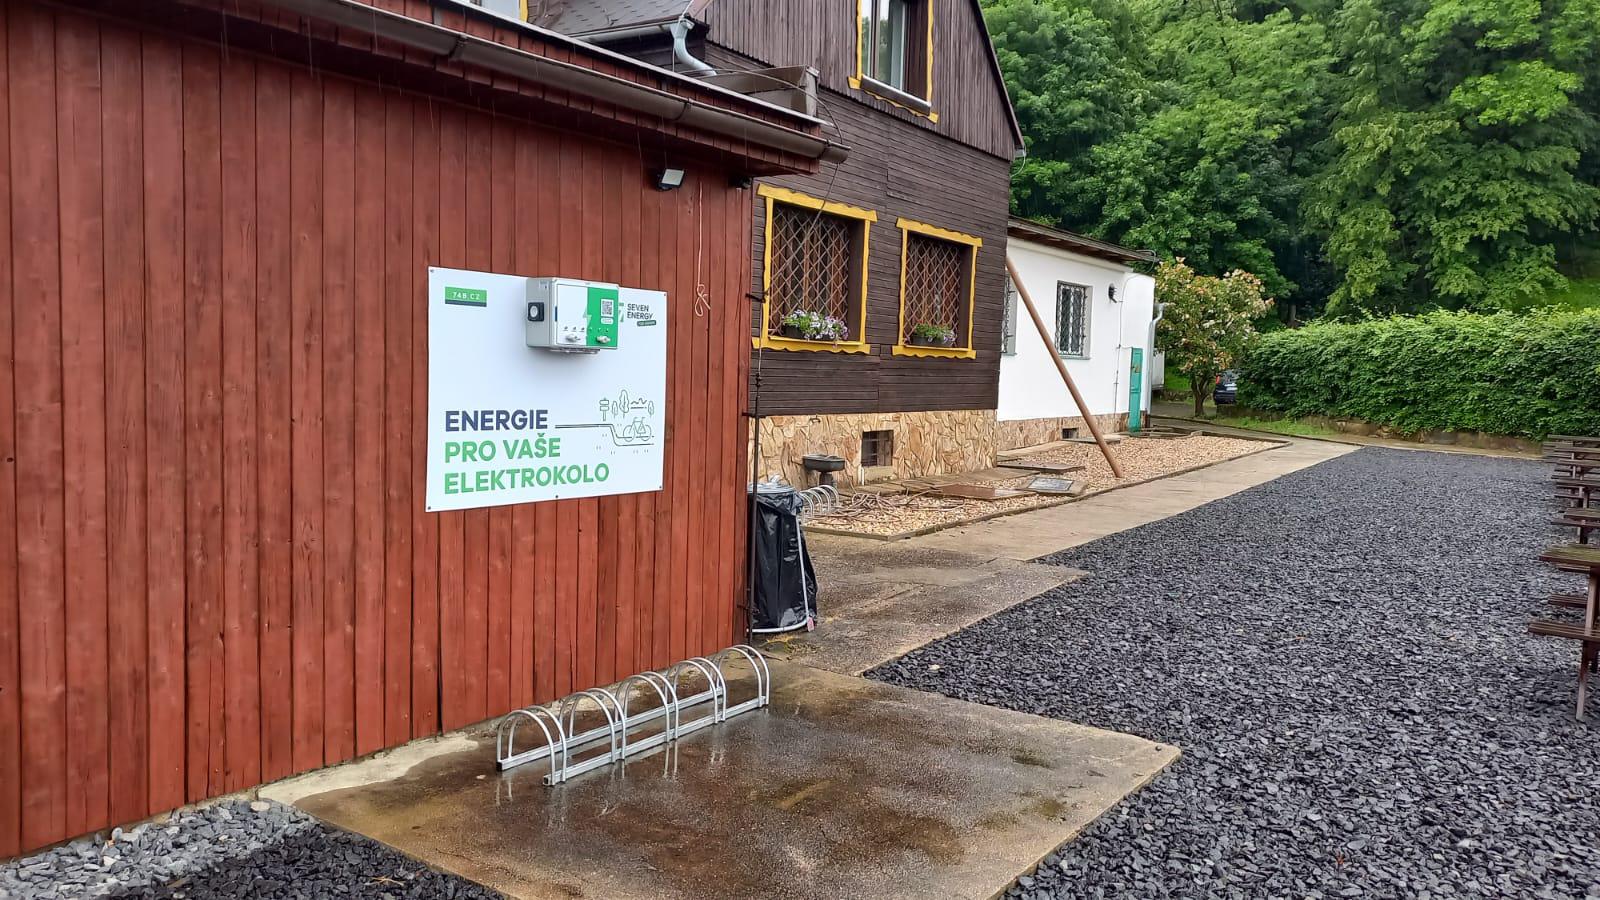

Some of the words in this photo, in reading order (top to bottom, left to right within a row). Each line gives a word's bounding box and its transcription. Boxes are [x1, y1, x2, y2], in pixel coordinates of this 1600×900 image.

[626, 312, 653, 320] ENERGY
[627, 304, 649, 312] SEVEN
[445, 409, 548, 432] ENERGIE
[444, 440, 496, 463] PRO
[503, 432, 561, 459] VAŠE
[444, 462, 610, 494] ELEKTROKOLO
